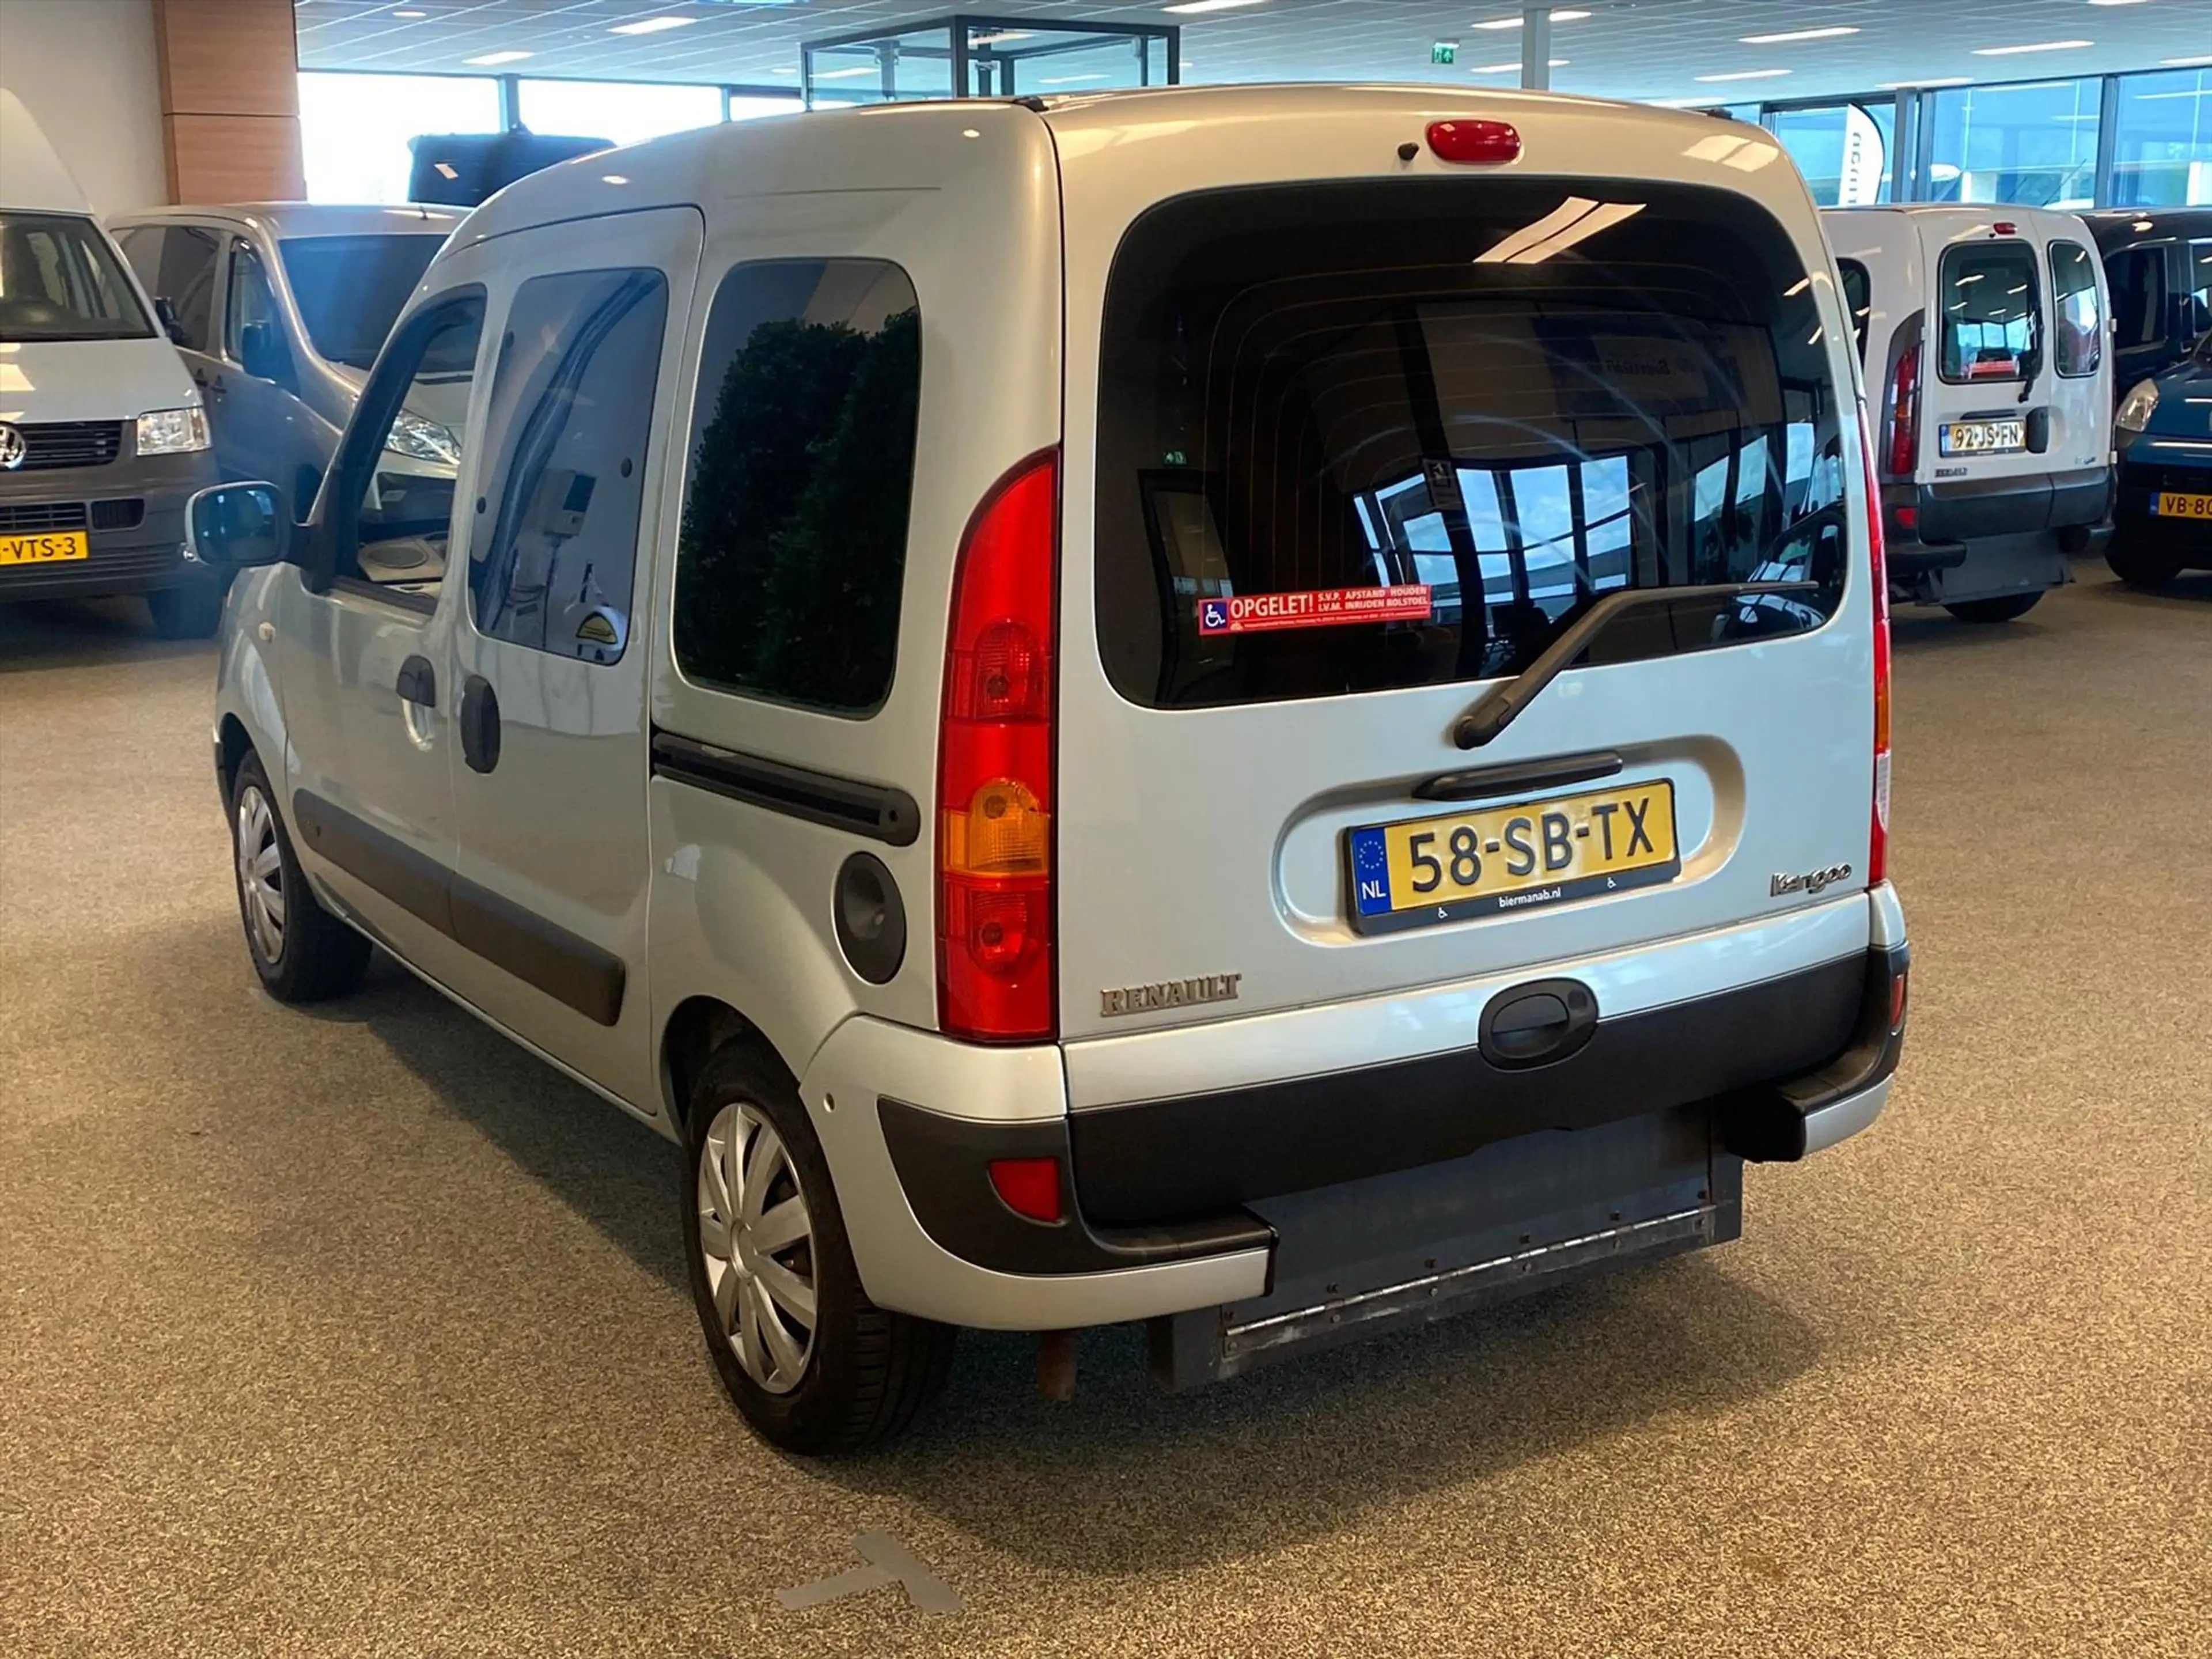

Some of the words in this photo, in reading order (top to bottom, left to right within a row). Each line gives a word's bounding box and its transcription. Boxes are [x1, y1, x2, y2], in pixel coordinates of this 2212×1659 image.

[0, 536, 76, 559] -VTS-3
[1318, 592, 1340, 601] S.V.P.
[1344, 589, 1385, 599] AFSTAND
[1390, 586, 1427, 596] HOUDEN
[1345, 600, 1384, 609] INRIJDEN
[1230, 593, 1313, 619] OPGELET!
[1410, 797, 1654, 893] 58-SB-TX
[1361, 879, 1386, 899] NL
[1770, 863, 1853, 897] Kangoo
[1498, 886, 1561, 908] biermanab.nl
[1100, 973, 1242, 1018] RENAULT
